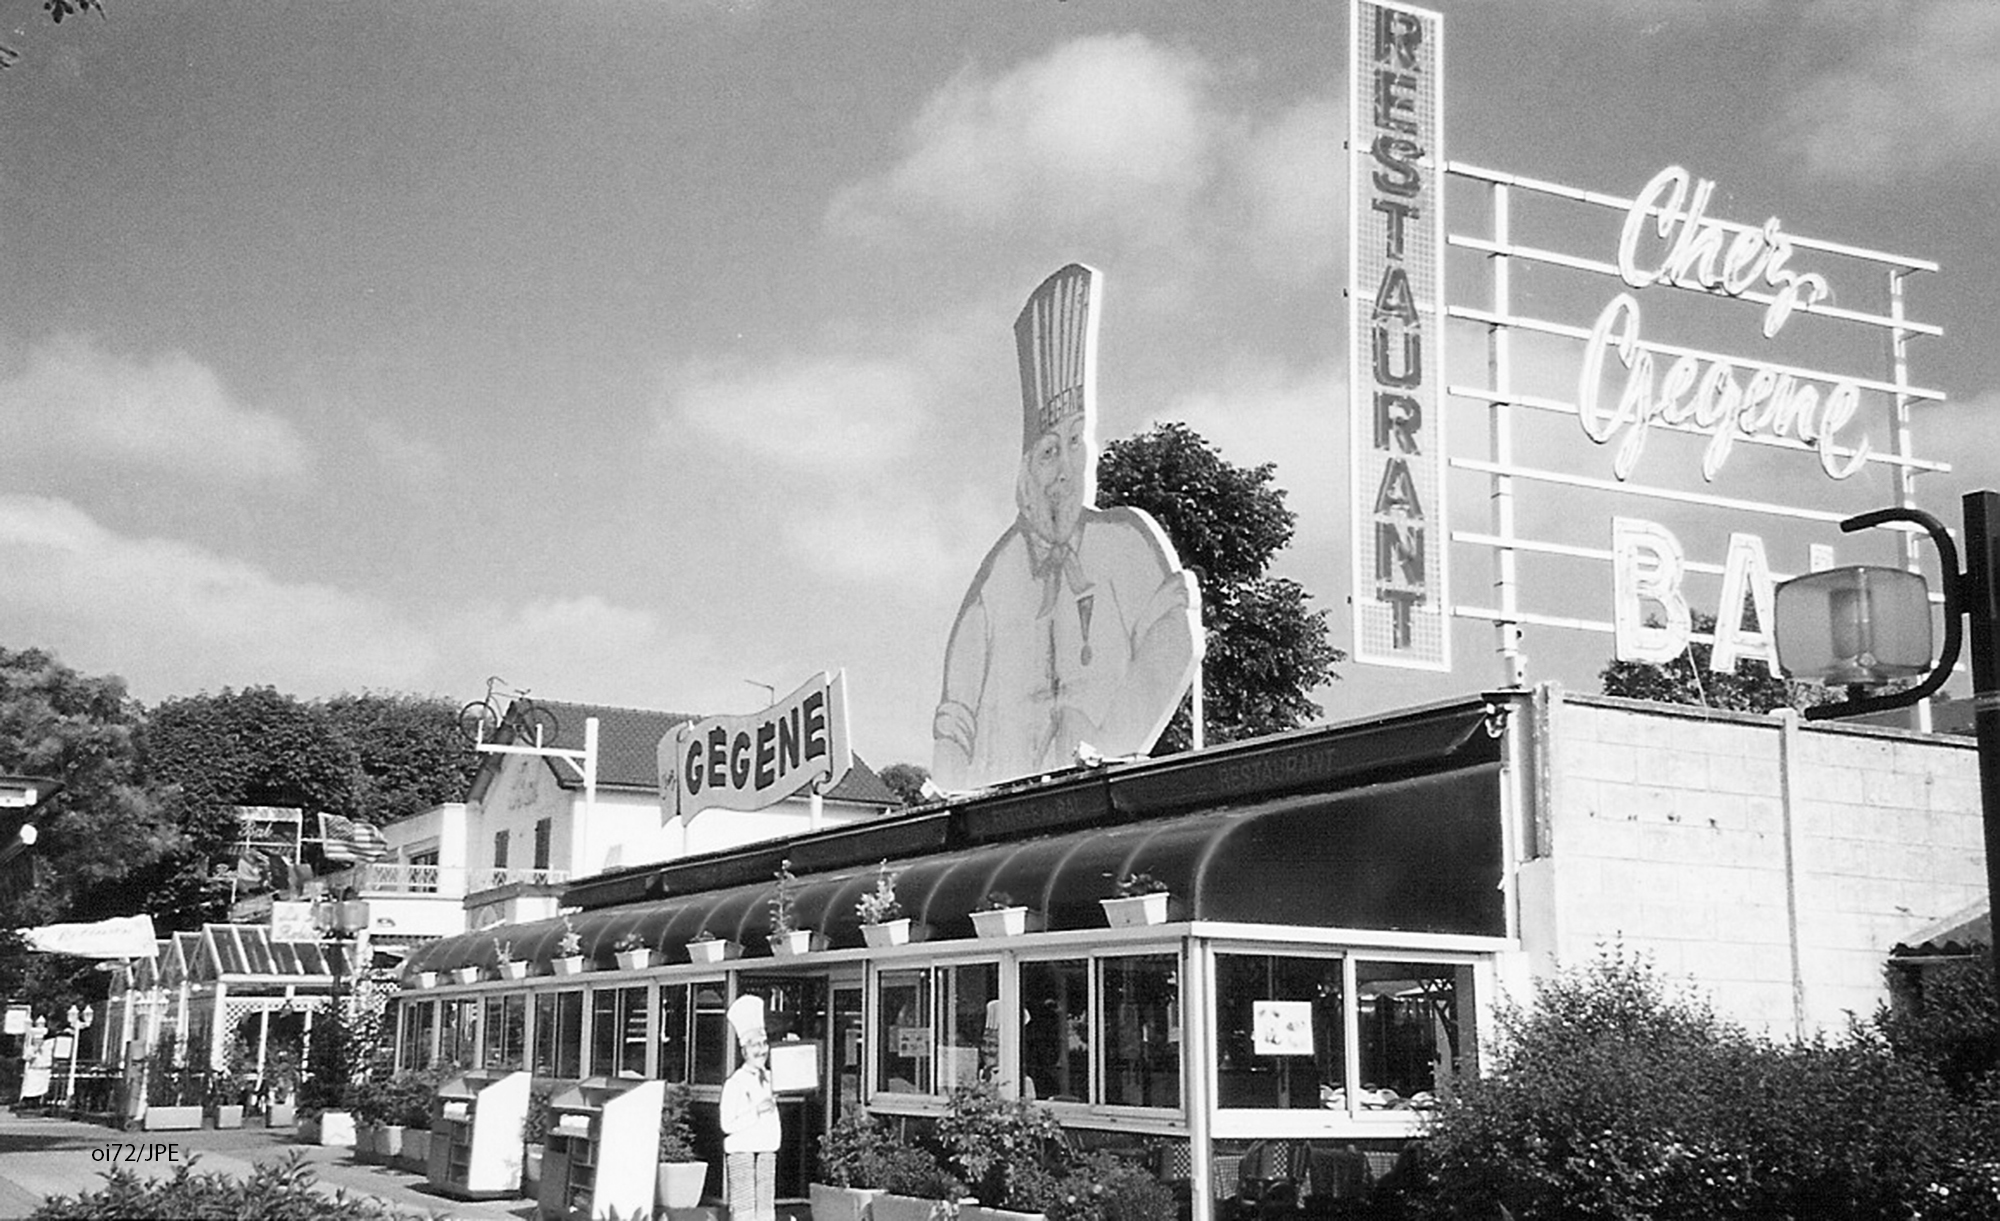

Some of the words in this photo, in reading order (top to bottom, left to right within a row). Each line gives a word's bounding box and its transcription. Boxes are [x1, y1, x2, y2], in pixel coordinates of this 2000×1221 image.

[1371, 5, 1426, 649] RESTAURANT
[1617, 165, 1828, 339] Chez
[1578, 292, 1873, 482] Gegene
[1611, 516, 1834, 680] BA
[1219, 747, 1336, 789] RESTAURANT
